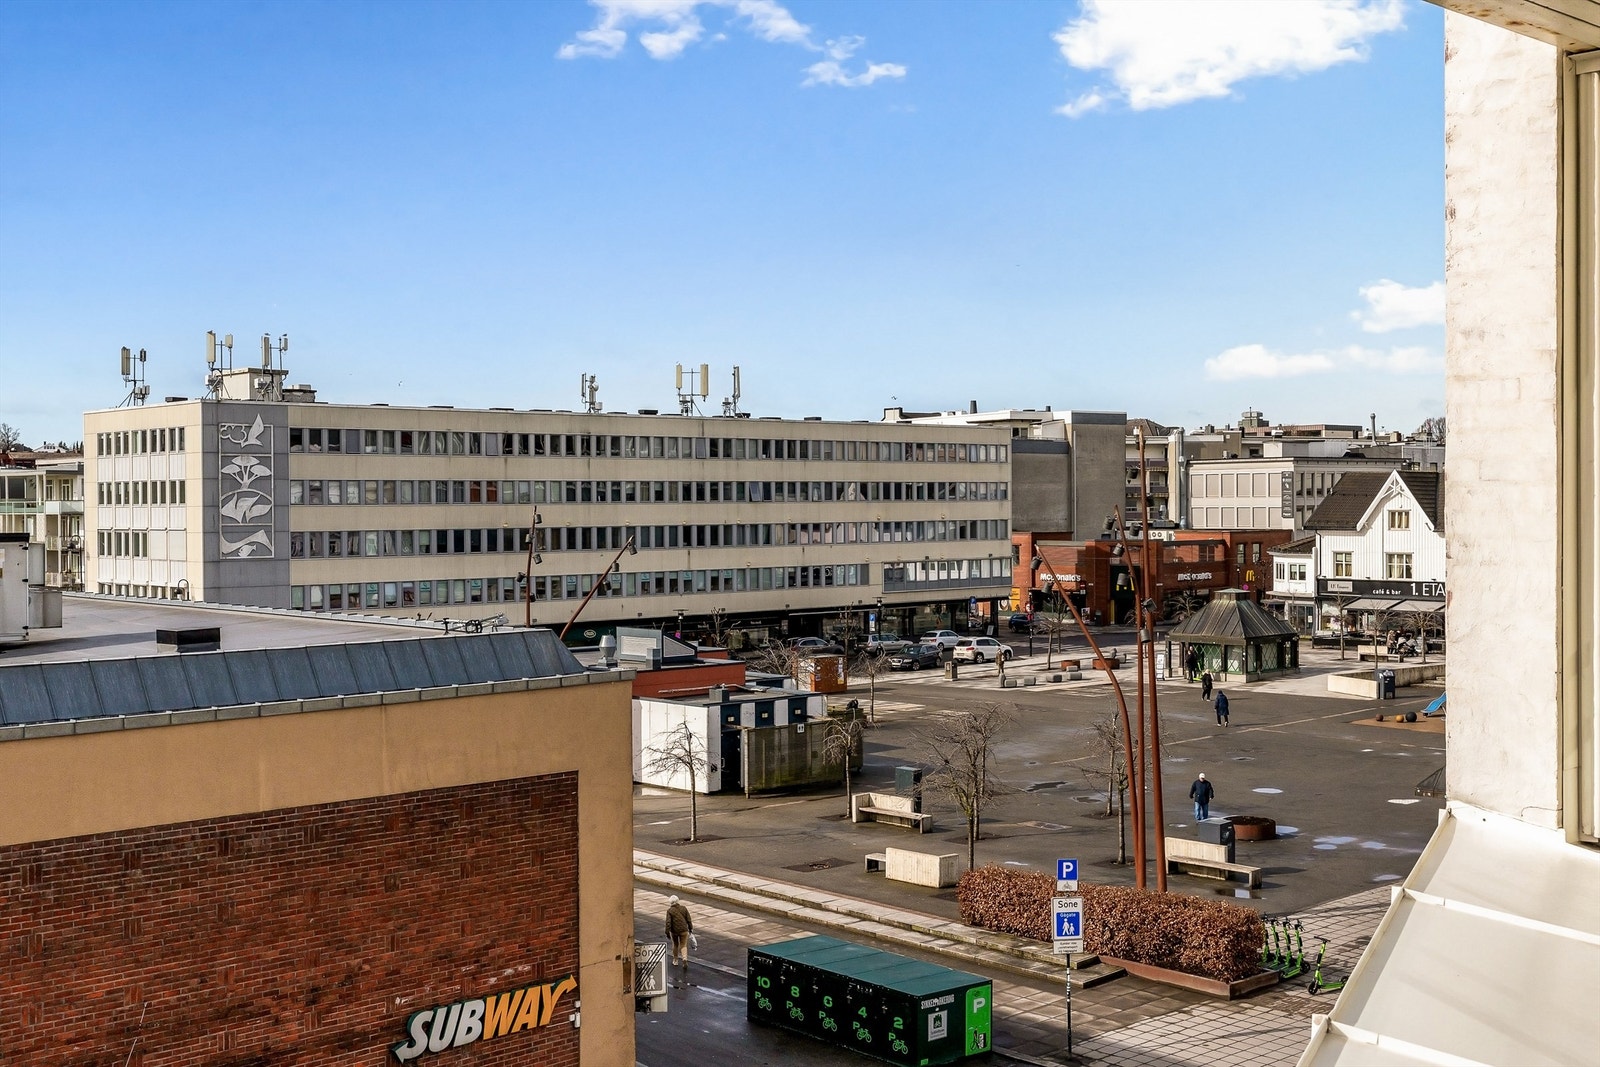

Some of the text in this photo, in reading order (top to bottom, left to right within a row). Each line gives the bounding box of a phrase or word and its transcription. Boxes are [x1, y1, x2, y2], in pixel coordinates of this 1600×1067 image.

[1062, 862, 1074, 878] P
[1057, 900, 1079, 909] Sone
[634, 947, 656, 957] Son
[756, 975, 771, 989] 10
[754, 991, 762, 1000] P
[790, 985, 800, 998] 8
[786, 1000, 794, 1009] P
[973, 997, 986, 1014] P
[818, 1010, 826, 1020] P
[857, 1006, 868, 1019] 4
[391, 974, 578, 1064] SUBWAY
[893, 1016, 904, 1030] 2
[852, 1021, 861, 1031] P
[888, 1032, 897, 1042] P
